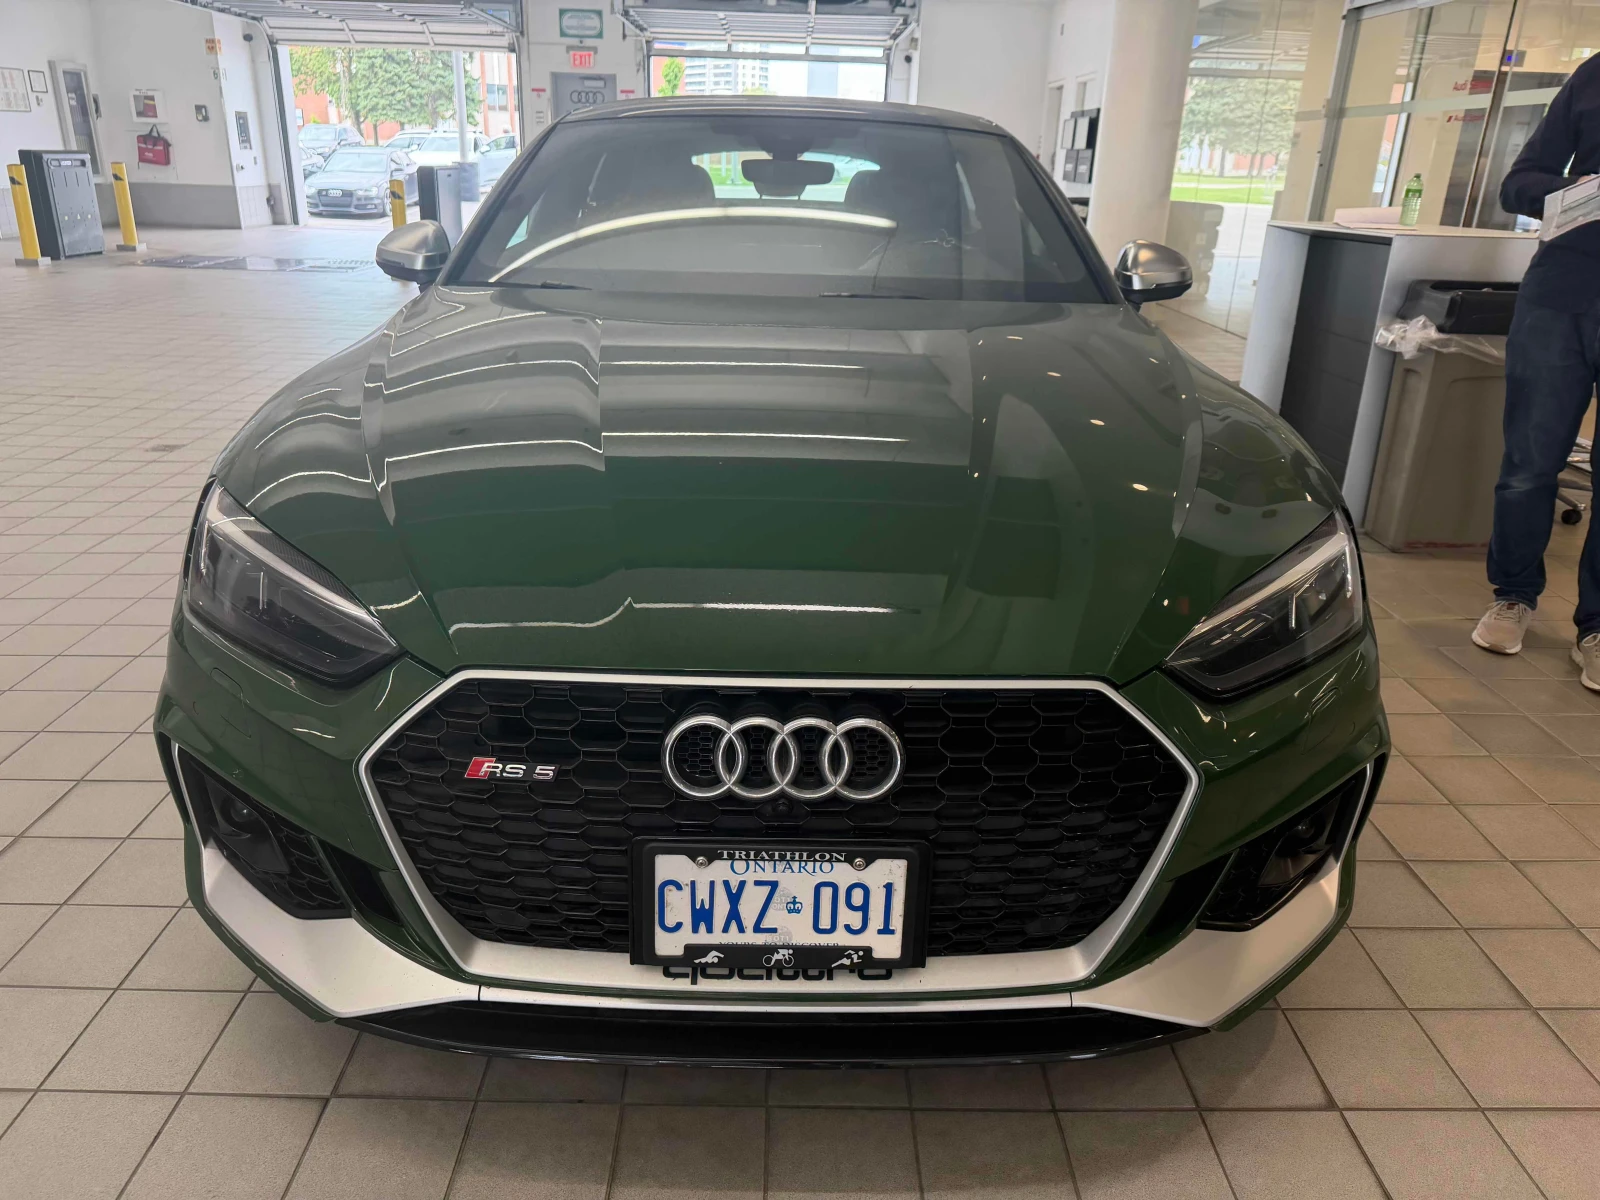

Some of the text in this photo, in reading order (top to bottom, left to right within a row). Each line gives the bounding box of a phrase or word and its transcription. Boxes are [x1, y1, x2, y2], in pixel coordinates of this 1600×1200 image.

[572, 52, 593, 67] EXIT
[479, 762, 555, 779] RS 5
[717, 850, 847, 861] TRIATHLON
[730, 860, 834, 876] ONTARIO
[658, 879, 896, 935] CWXZ 091
